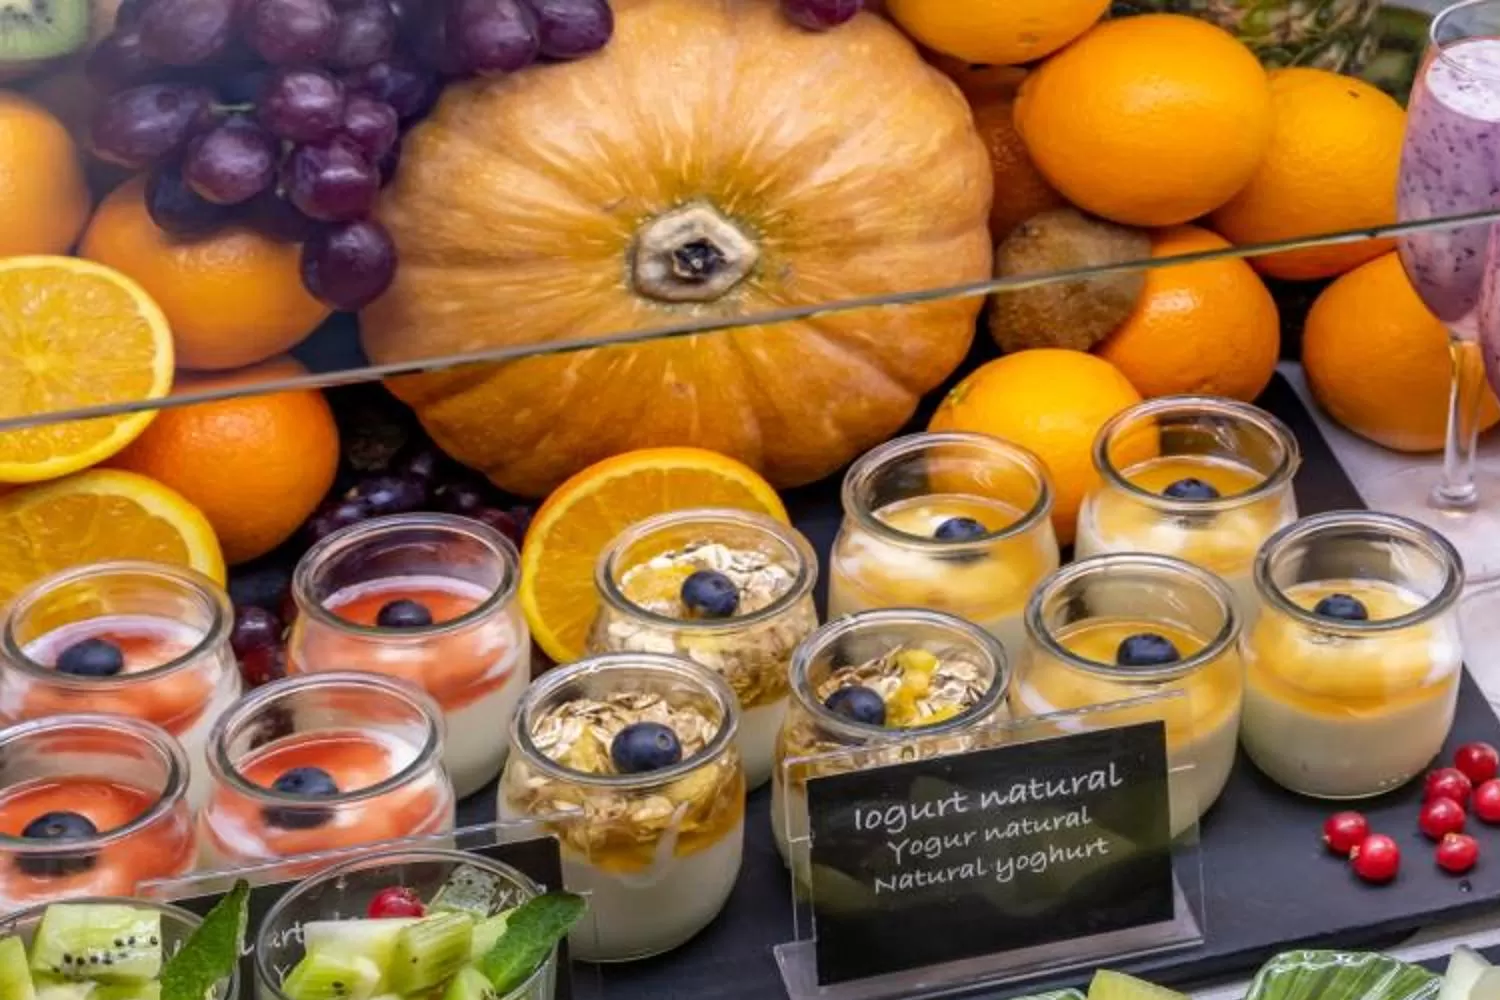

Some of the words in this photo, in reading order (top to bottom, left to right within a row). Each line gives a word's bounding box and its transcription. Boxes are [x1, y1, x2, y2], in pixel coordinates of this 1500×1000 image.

[854, 790, 969, 832] Iogurt
[980, 763, 1124, 810] natural
[888, 827, 976, 865] Yogur
[984, 805, 1092, 840] natural
[874, 859, 987, 895] Natural
[995, 838, 1109, 881] yoghurt
